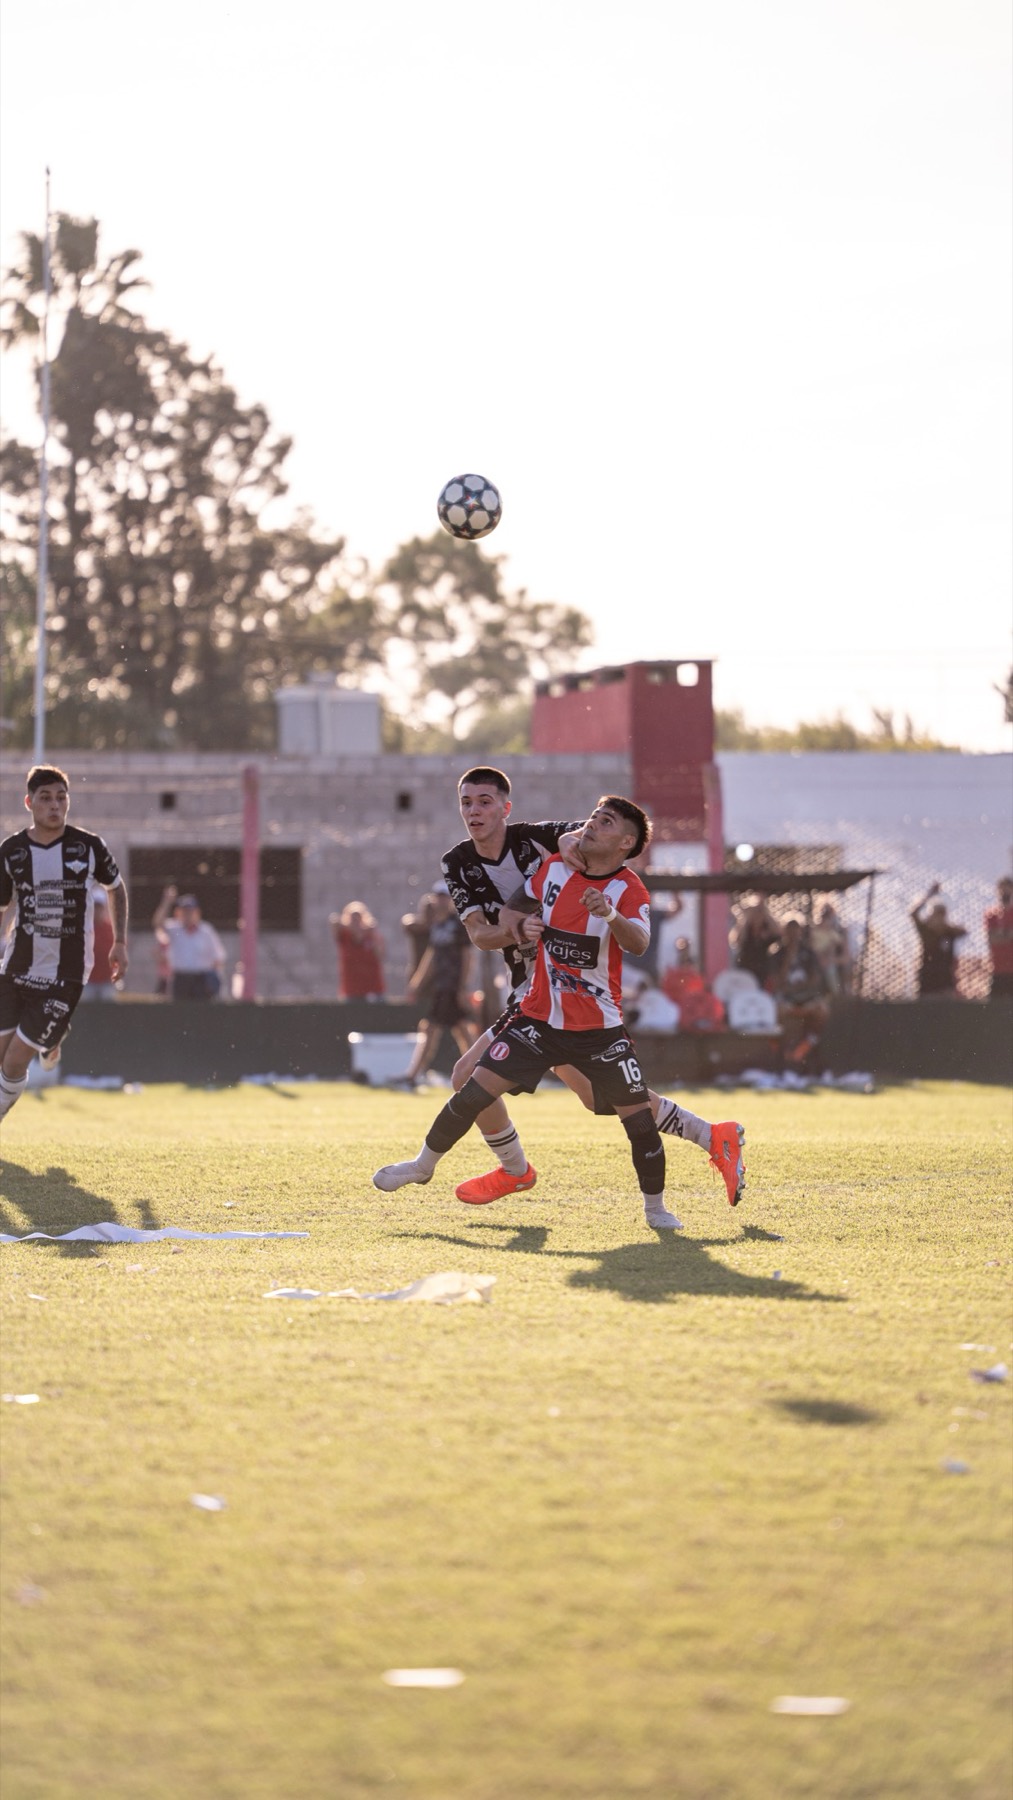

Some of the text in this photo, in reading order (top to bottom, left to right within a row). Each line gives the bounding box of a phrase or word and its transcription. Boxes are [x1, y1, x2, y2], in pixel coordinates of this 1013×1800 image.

[543, 881, 561, 907] 16
[553, 937, 577, 947] tarjeta
[41, 1021, 57, 1039] 5
[617, 1057, 642, 1084] 16
